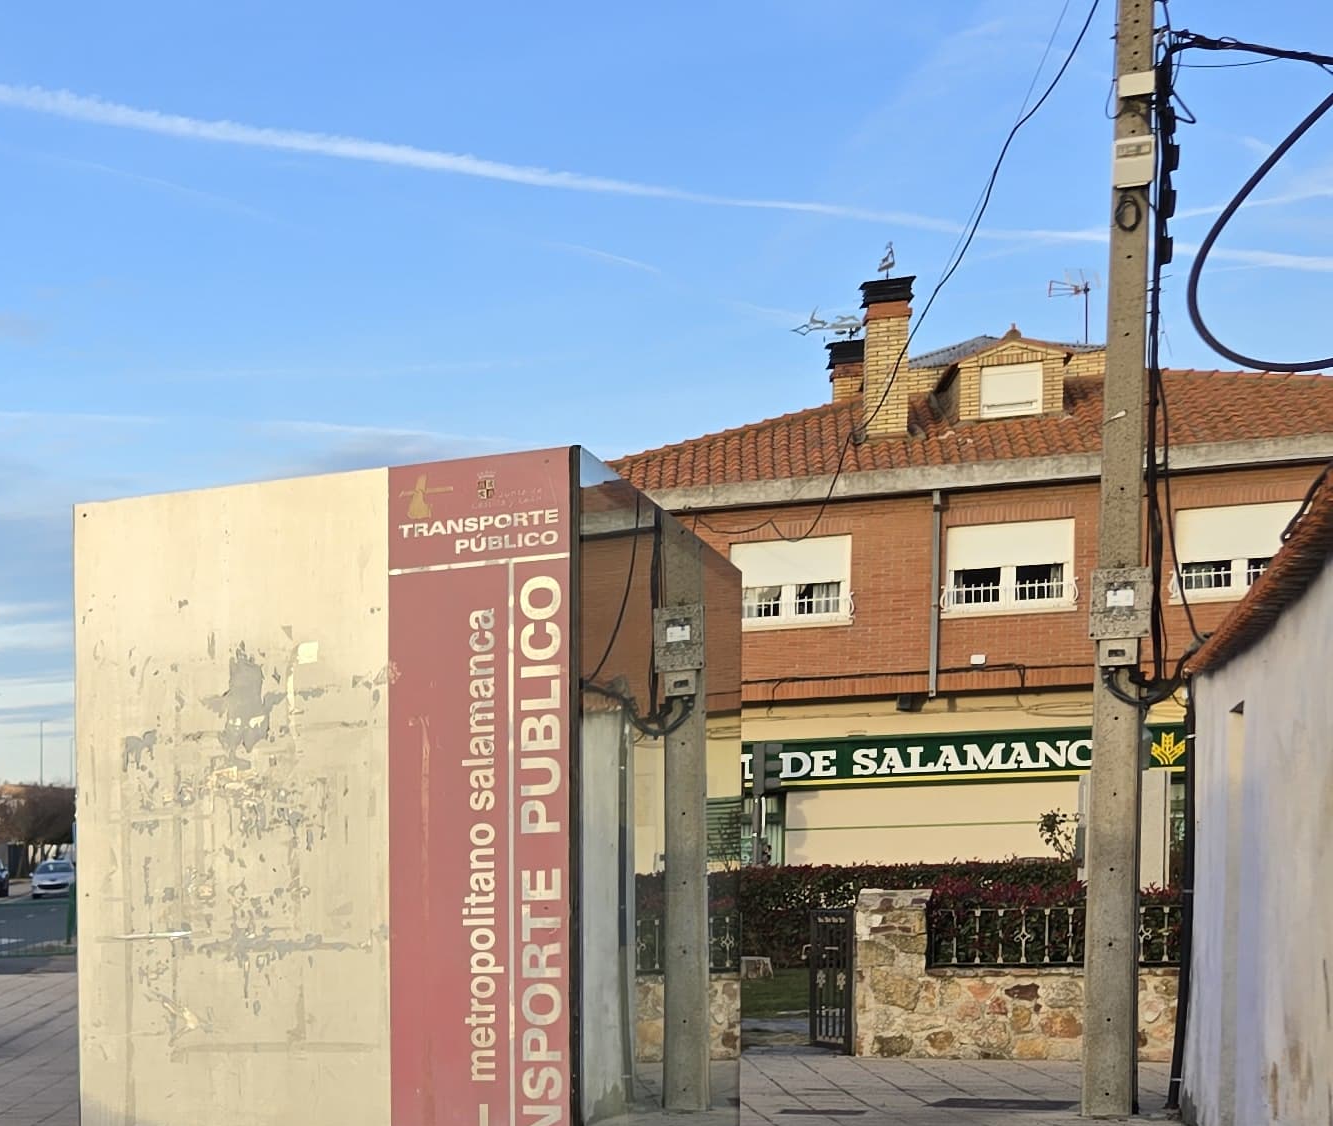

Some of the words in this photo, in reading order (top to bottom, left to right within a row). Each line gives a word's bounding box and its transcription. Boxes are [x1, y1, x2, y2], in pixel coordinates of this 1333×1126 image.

[398, 508, 559, 539] TRANSPORTE
[454, 530, 559, 554] PÚBLICO
[461, 607, 495, 811] salamanca
[519, 575, 562, 834] PUBLICO
[778, 749, 837, 779] DE
[852, 740, 1093, 776] SALAMANC
[462, 822, 505, 1081] metropolitano
